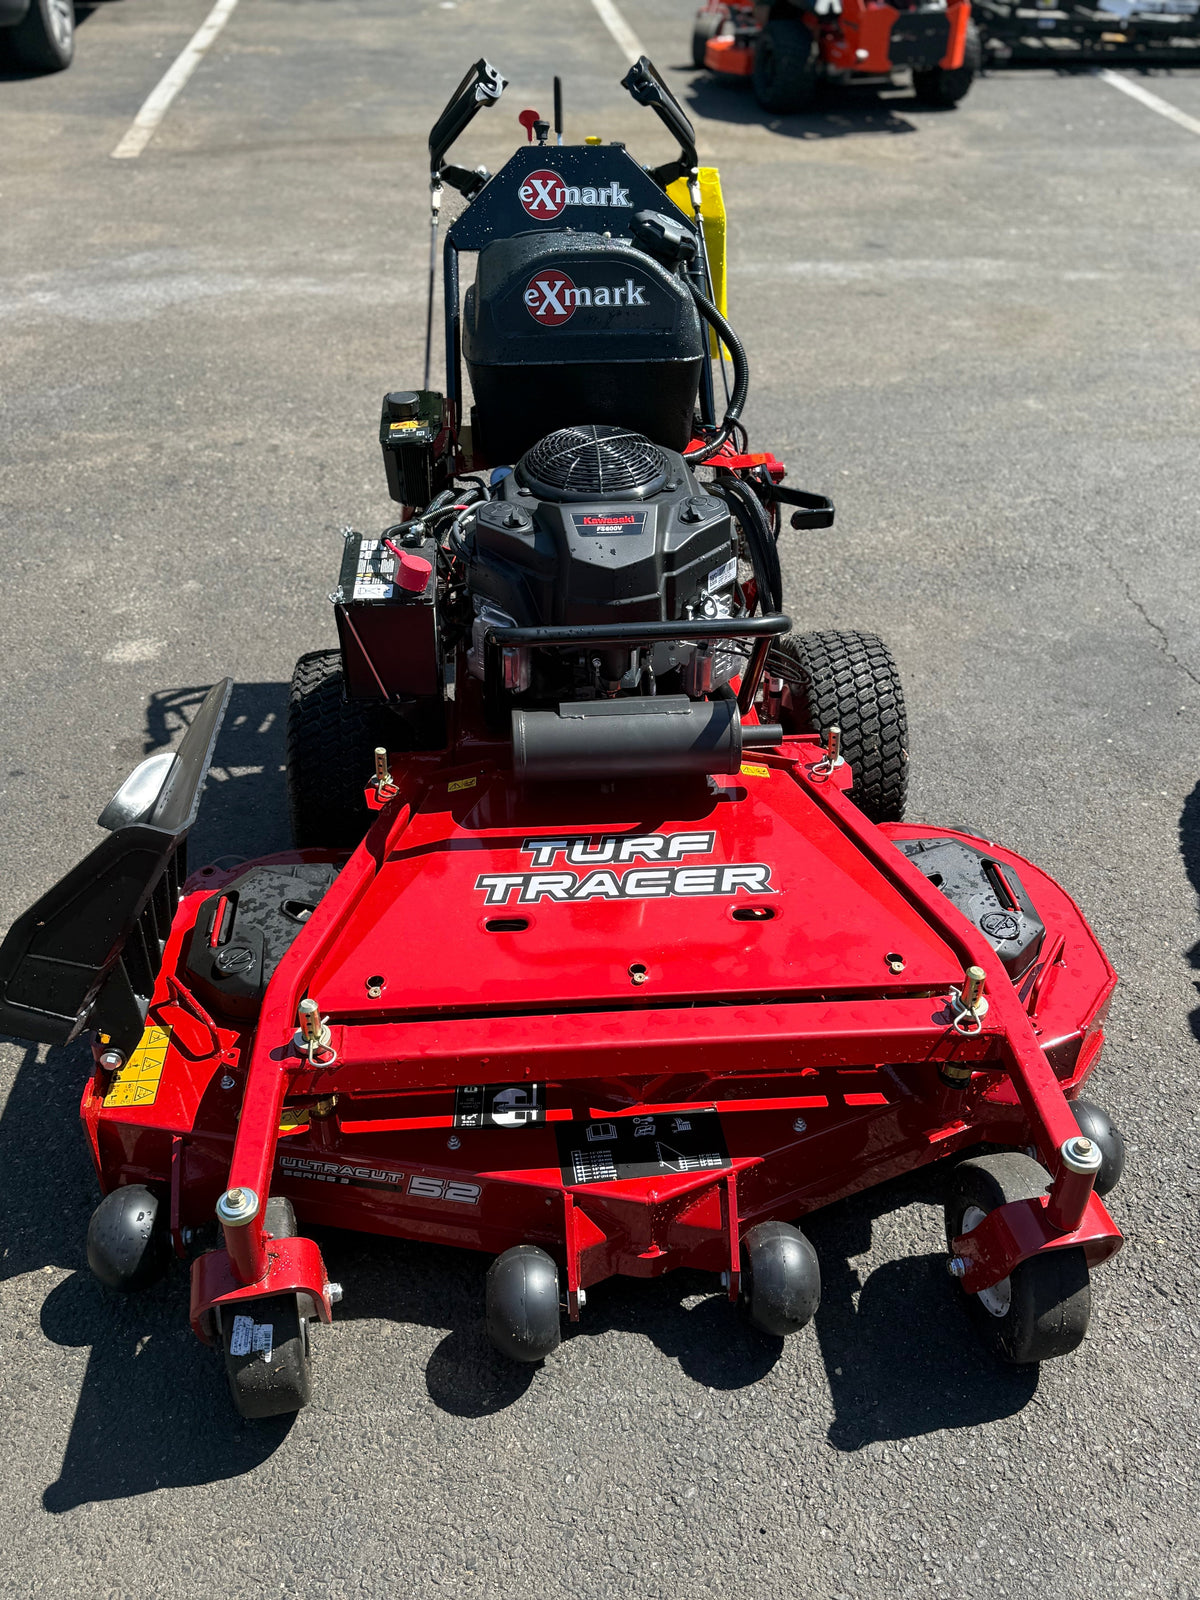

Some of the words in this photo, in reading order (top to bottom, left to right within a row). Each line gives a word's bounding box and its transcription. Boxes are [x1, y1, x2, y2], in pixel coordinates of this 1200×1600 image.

[518, 179, 631, 211] eXmark
[524, 278, 646, 315] eXmark
[583, 515, 635, 525] Kawasaki
[521, 831, 716, 867] TURF
[474, 863, 776, 905] TRACER
[279, 1156, 404, 1183] ULTRACUT
[406, 1175, 481, 1205] 52
[284, 1169, 337, 1183] SERIES
